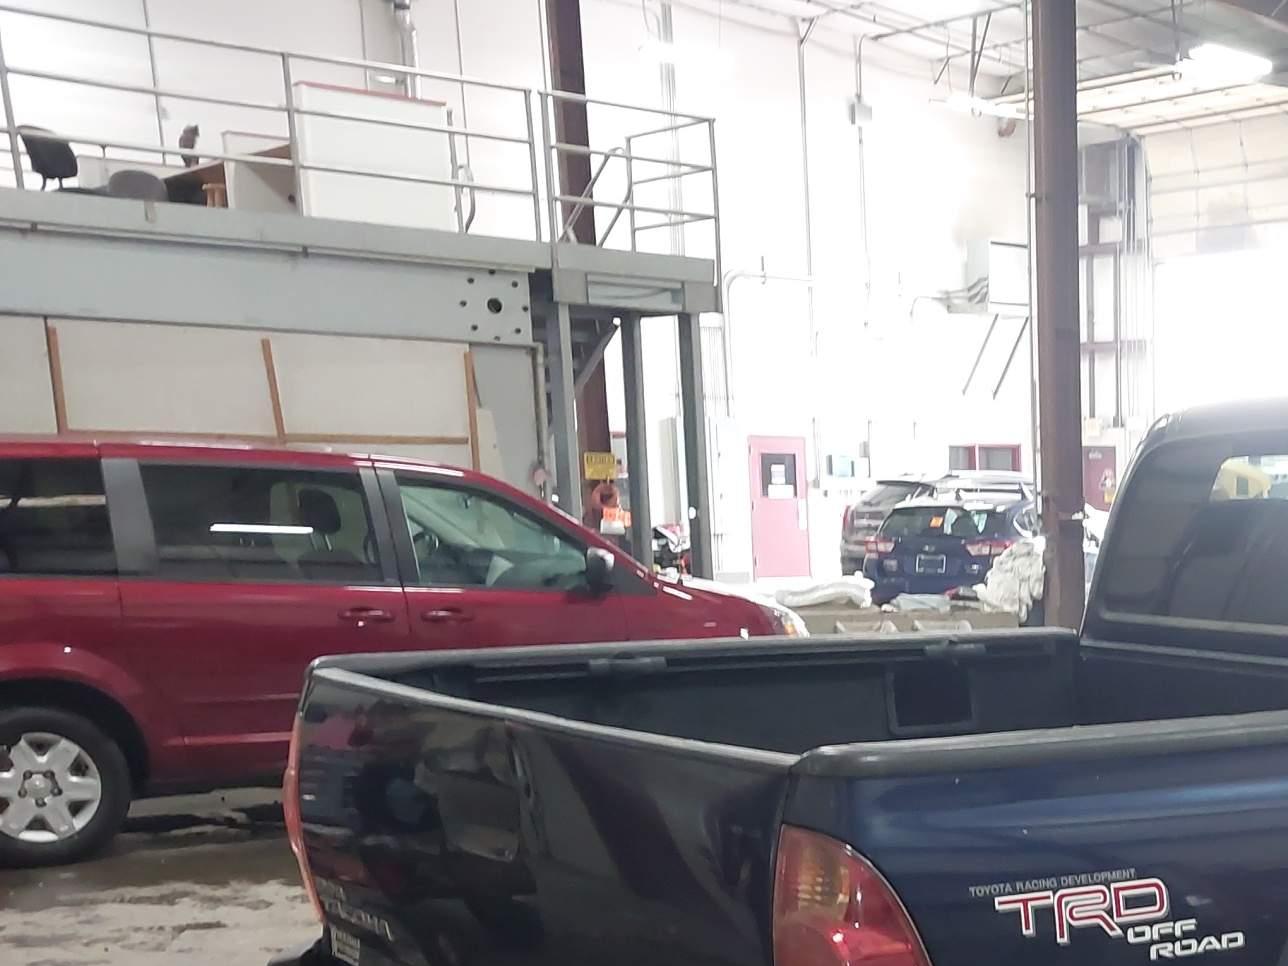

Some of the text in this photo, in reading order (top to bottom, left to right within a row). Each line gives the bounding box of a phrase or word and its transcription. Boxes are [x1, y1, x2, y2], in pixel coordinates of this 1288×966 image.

[969, 868, 1136, 897] TOYOTA RACING DEVELOPMENT
[994, 878, 1170, 945] TRD
[1127, 918, 1197, 944] OFF
[1150, 931, 1245, 961] ROAD
